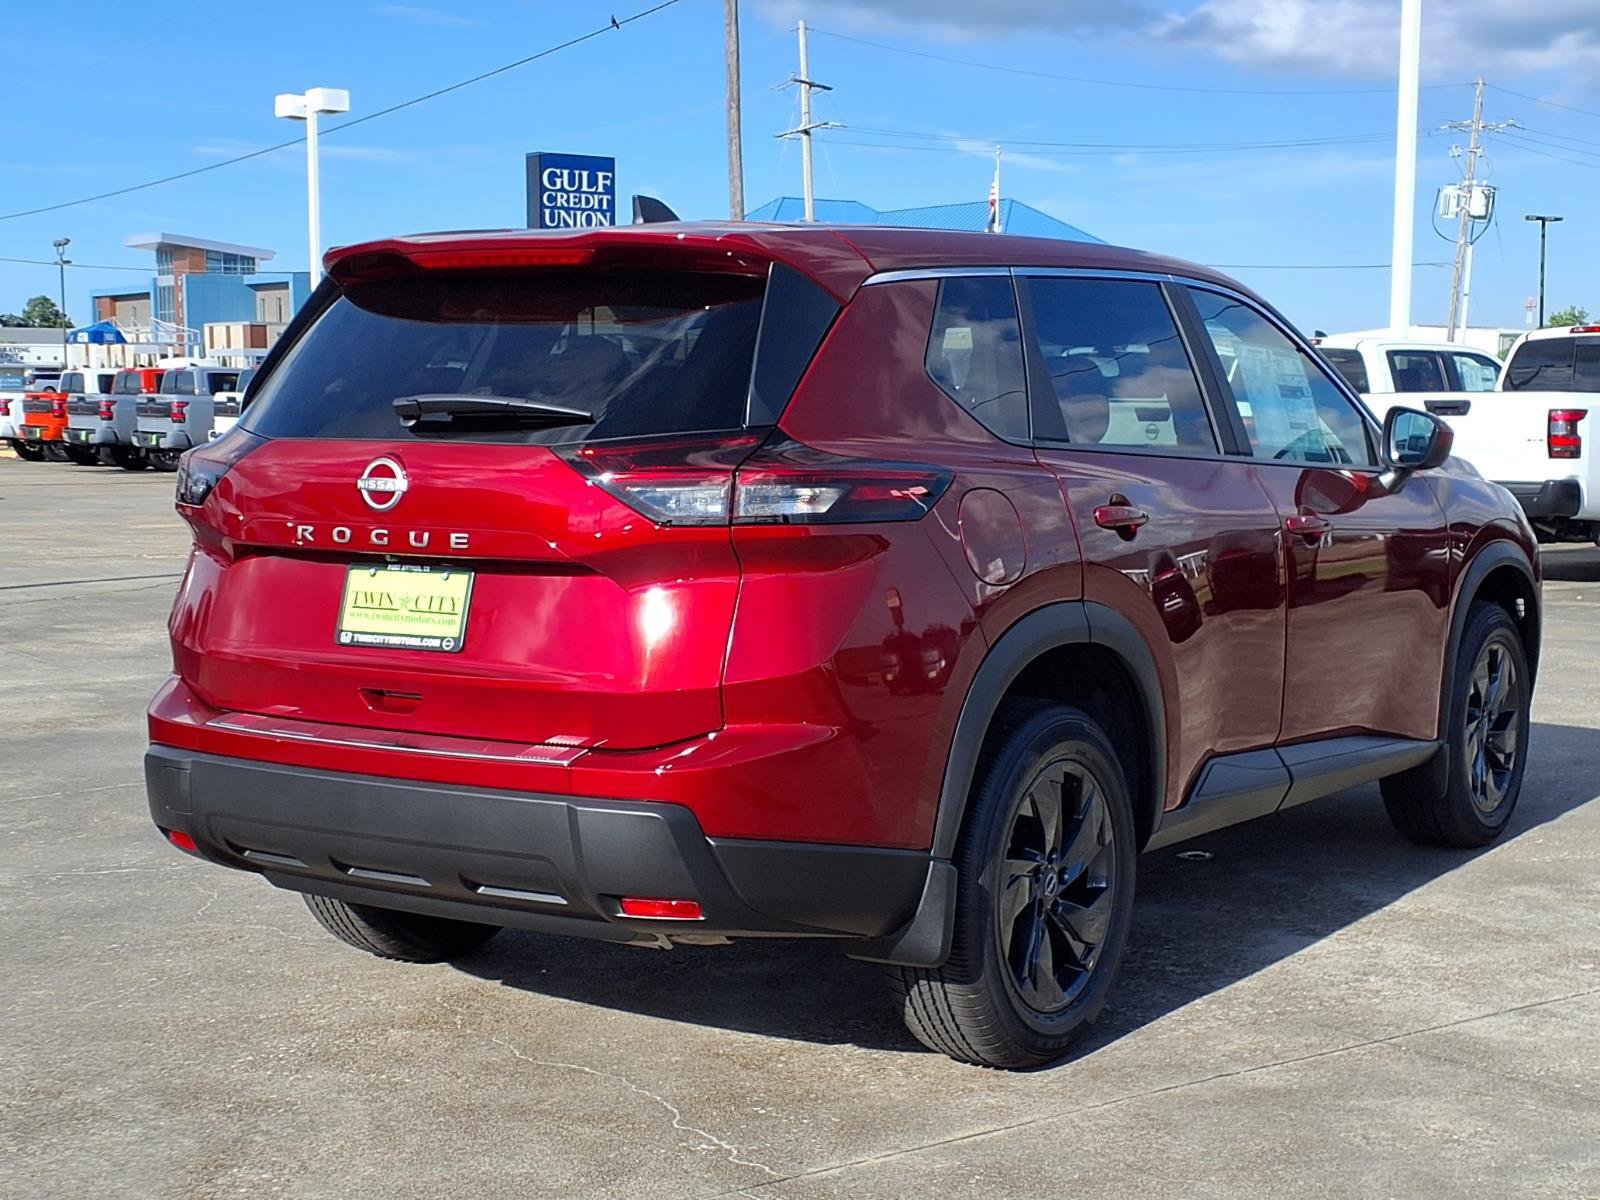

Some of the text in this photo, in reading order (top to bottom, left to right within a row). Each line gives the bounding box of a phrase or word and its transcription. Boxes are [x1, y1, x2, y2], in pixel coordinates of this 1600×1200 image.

[542, 167, 613, 193] GULF
[542, 191, 612, 210] CREDIT
[544, 208, 612, 228] UNION
[296, 525, 469, 549] ROGUE
[352, 590, 461, 612] TWIN CITY
